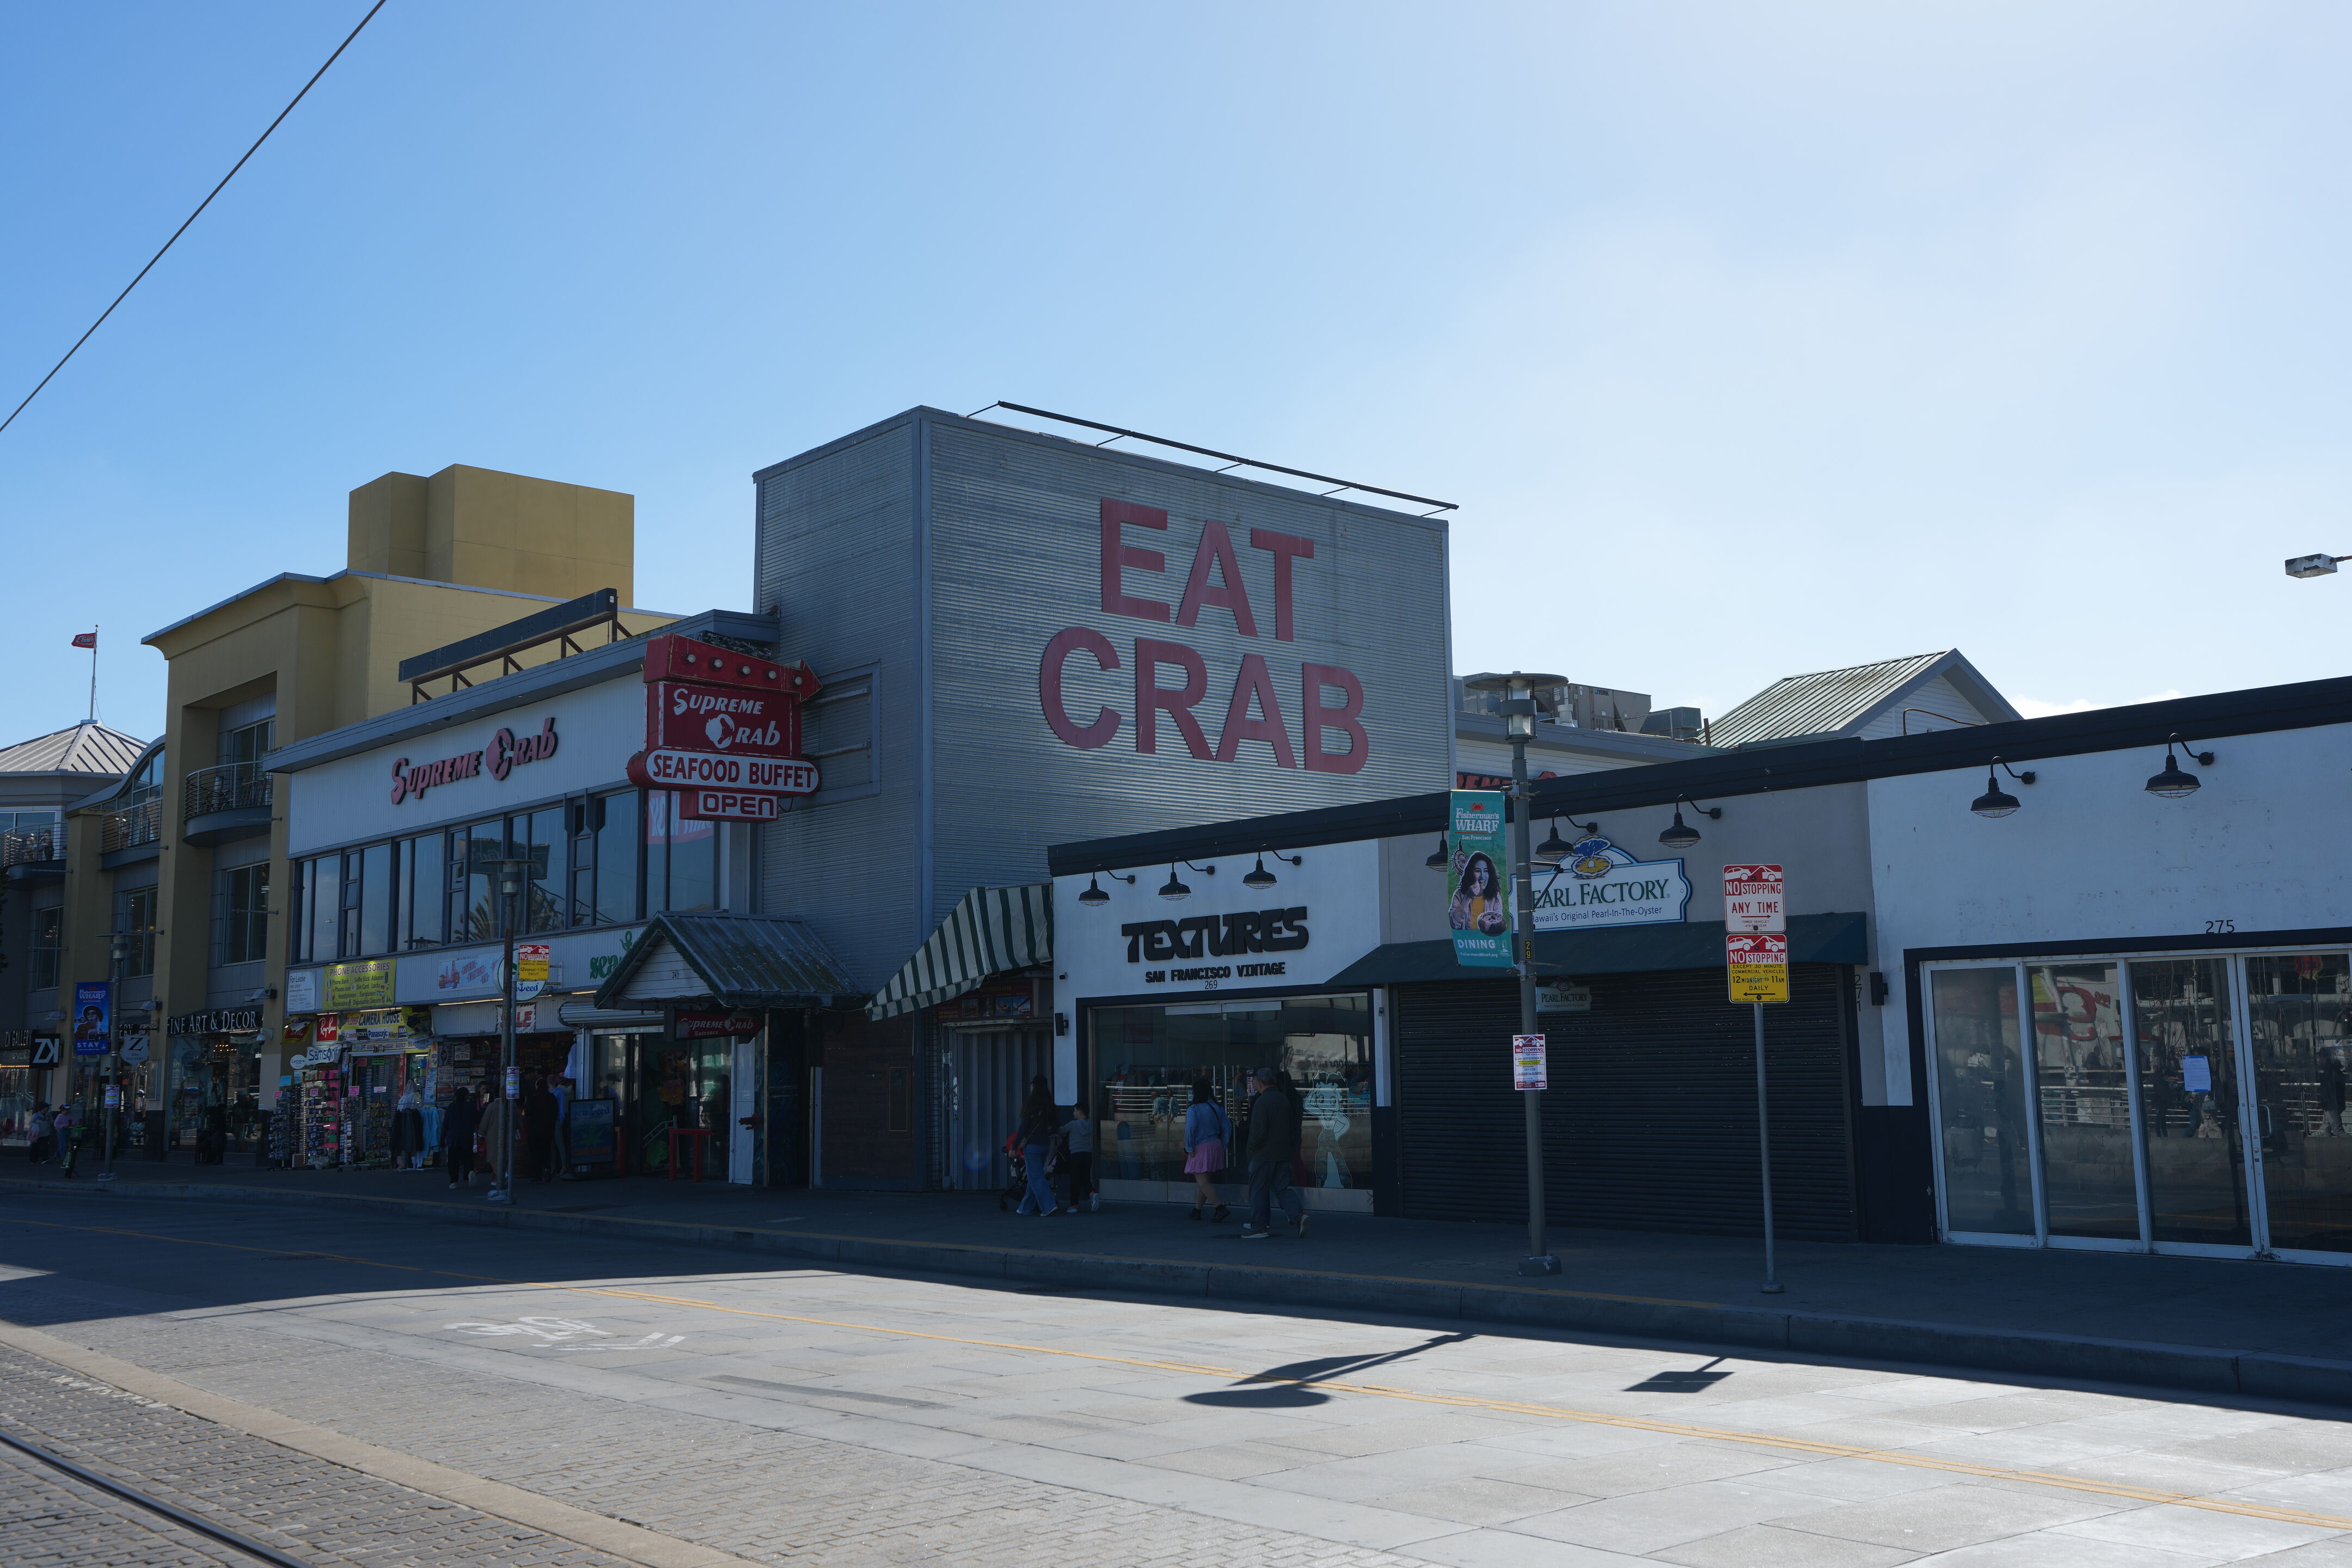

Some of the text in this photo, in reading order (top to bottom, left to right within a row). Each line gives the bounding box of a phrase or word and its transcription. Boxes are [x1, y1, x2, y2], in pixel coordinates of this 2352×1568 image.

[1101, 498, 1314, 642] EAT
[1040, 627, 1369, 774] CRAB
[653, 754, 815, 788] SEAFOOD BUFFET
[703, 794, 774, 816] OPEN
[1455, 808, 1499, 819] Fisherman's
[1455, 819, 1499, 834] WHARF
[1532, 879, 1669, 909] EARL FACTORY
[1726, 881, 1781, 895] NO STOPPING
[1561, 912, 1589, 922] Original
[1591, 906, 1662, 918] Pearl-In-The-Oyster
[1732, 902, 1779, 913] ANY TIME
[1122, 906, 1309, 963] TEXTURES
[2206, 920, 2234, 934] 275
[1457, 939, 1496, 950] DINING
[1730, 951, 1784, 963] NO STOPPING
[330, 962, 390, 976] PHONE ACCESSORIES
[1146, 962, 1285, 983] SAN FRANCISCO VINTAGE
[1204, 981, 1218, 990] 269
[1541, 993, 1588, 1002] PEARL FACTORY
[166, 1011, 257, 1034] FINE ART & DECOR
[359, 1012, 381, 1026] CAMERA
[382, 1011, 399, 1024] HOUSE
[319, 1016, 336, 1038] Ray-Ban
[368, 1029, 388, 1038] Panasonic
[12, 1030, 33, 1046] GALLERY
[128, 1037, 143, 1051] Z
